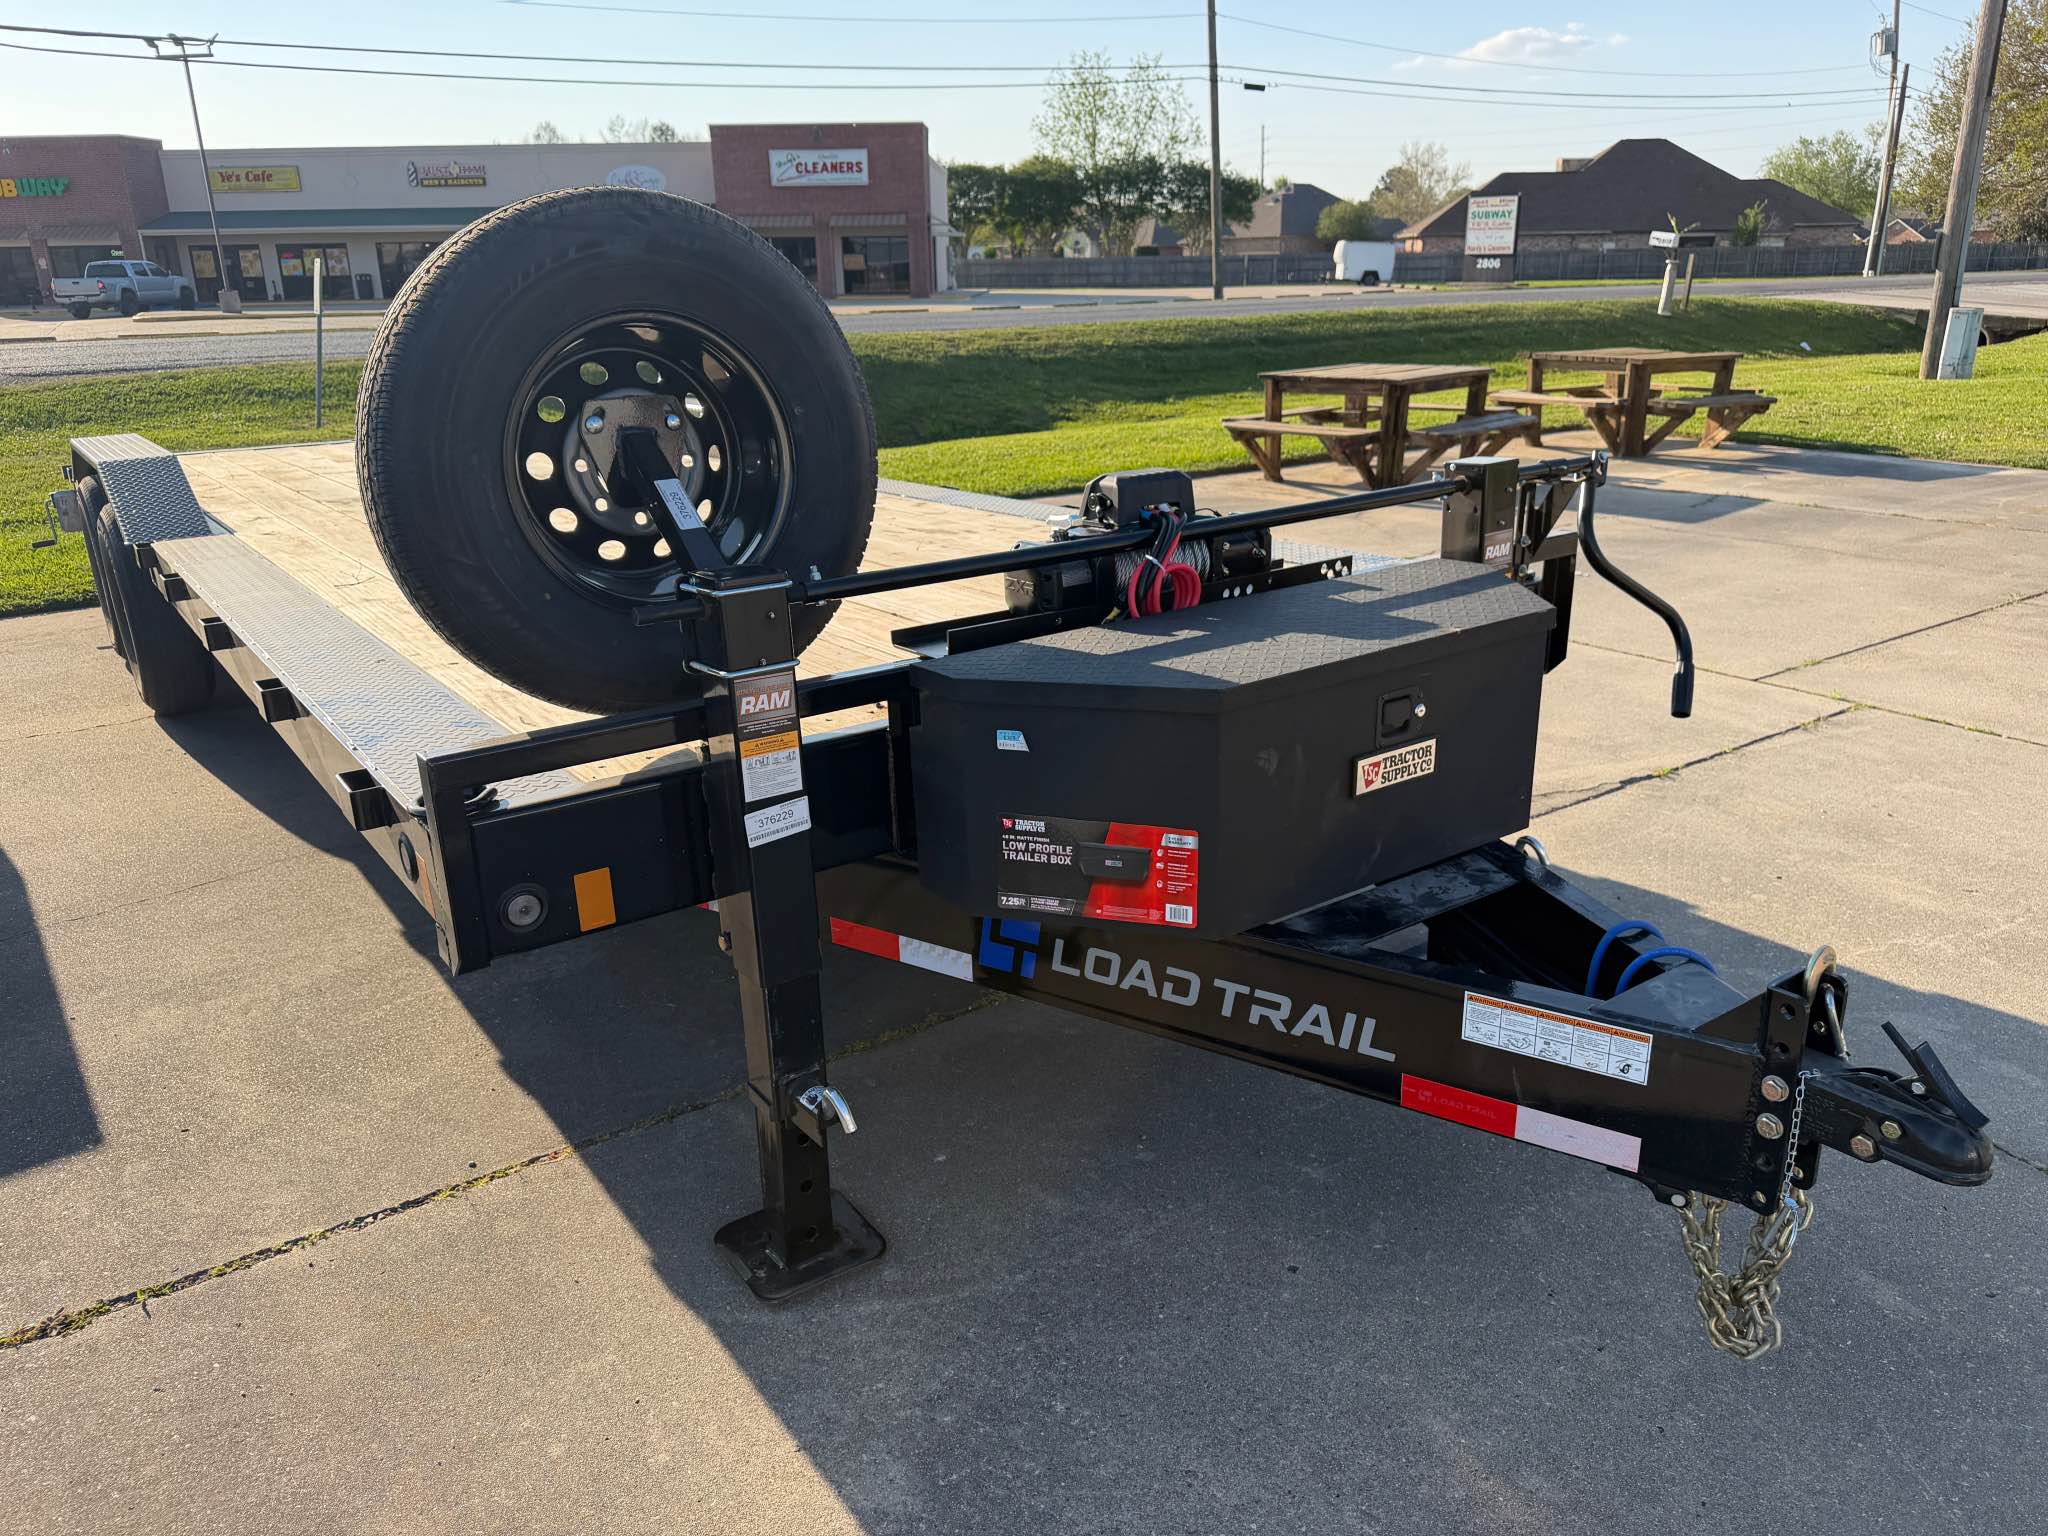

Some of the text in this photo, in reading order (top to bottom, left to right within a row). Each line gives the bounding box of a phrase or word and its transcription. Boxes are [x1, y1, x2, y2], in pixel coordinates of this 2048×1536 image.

[795, 161, 863, 174] CLEANERS
[217, 169, 273, 183] Ye's Cafe
[0, 176, 70, 198] BWAY
[1471, 209, 1513, 219] SUBWAY
[1476, 257, 1501, 269] 2806
[670, 490, 693, 520] 376229
[1485, 542, 1511, 560] RAM
[740, 689, 791, 716] RAM
[1382, 745, 1433, 770] TRACTOR
[1363, 764, 1379, 783] TSC
[1381, 762, 1420, 785] SUPPLY
[758, 809, 794, 828] 376229
[1002, 840, 1073, 856] LOW PROFILE
[1002, 850, 1073, 865] TRAILER BOX
[1001, 896, 1020, 906] 7.25
[1051, 938, 1396, 1063] LOAD TRAIL
[1472, 996, 1502, 1008] WARNING
[1508, 1004, 1537, 1017] WARNING
[1545, 1012, 1574, 1025] WARNING
[1581, 1021, 1611, 1034] WARNING
[1618, 1031, 1650, 1043] WARNING
